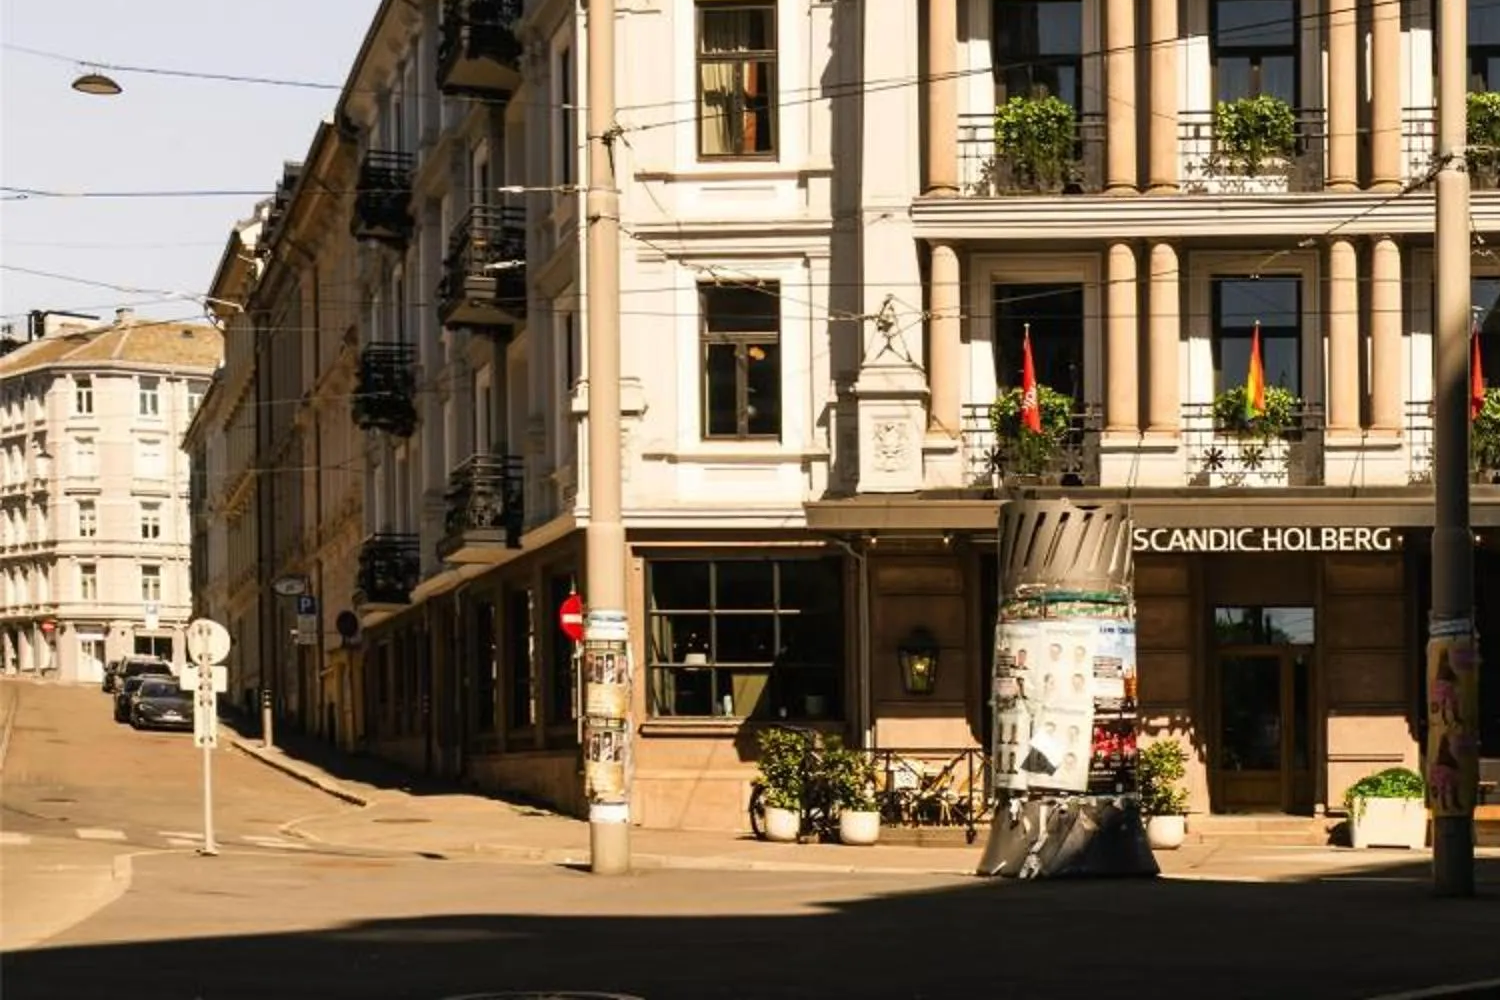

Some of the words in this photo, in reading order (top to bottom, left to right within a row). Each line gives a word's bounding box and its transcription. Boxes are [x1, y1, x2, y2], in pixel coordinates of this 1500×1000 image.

[1133, 527, 1259, 551] SCANDIC
[1263, 527, 1392, 551] HOLBERG
[301, 597, 312, 612] P
